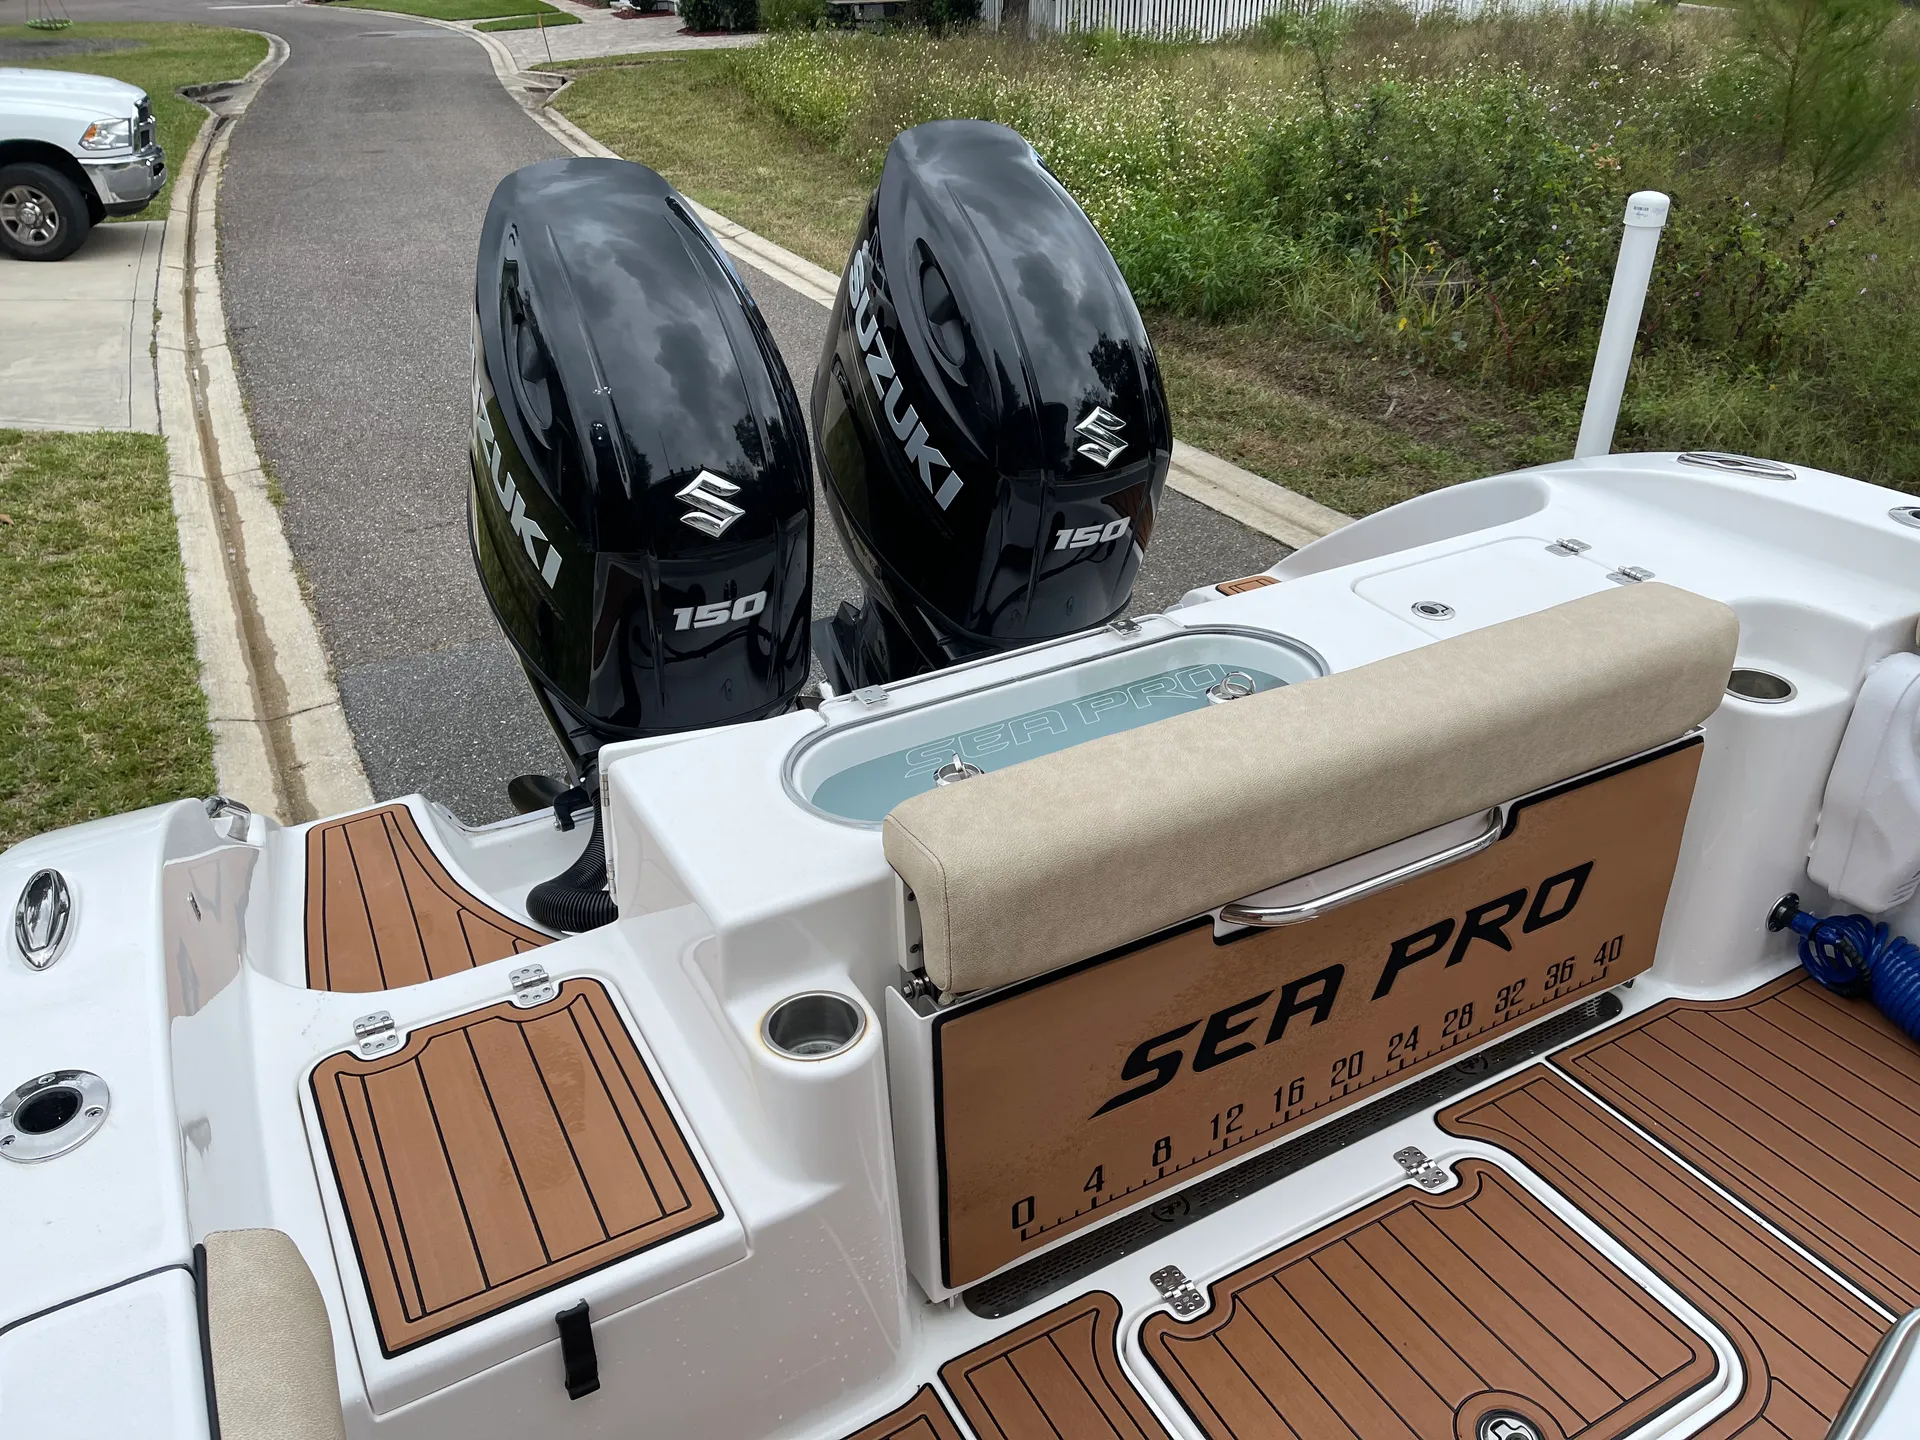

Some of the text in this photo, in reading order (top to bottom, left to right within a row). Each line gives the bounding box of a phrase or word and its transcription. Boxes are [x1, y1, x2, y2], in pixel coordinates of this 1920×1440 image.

[850, 248, 964, 511] SUZUKI
[673, 590, 768, 632] 150
[1053, 516, 1131, 551] 150
[904, 662, 1229, 778] SEA PRO
[1083, 1164, 1105, 1193] 4
[1152, 1135, 1172, 1167] 8
[1210, 1103, 1244, 1140] 12
[1273, 1076, 1305, 1113] 16
[1331, 1050, 1364, 1088] 20
[1387, 1025, 1419, 1062] 24
[1442, 1001, 1474, 1038] 28
[1494, 978, 1527, 1014] 32
[1544, 956, 1576, 991] 36
[1593, 934, 1624, 967] 40
[1088, 860, 1595, 1120] SEA PRO
